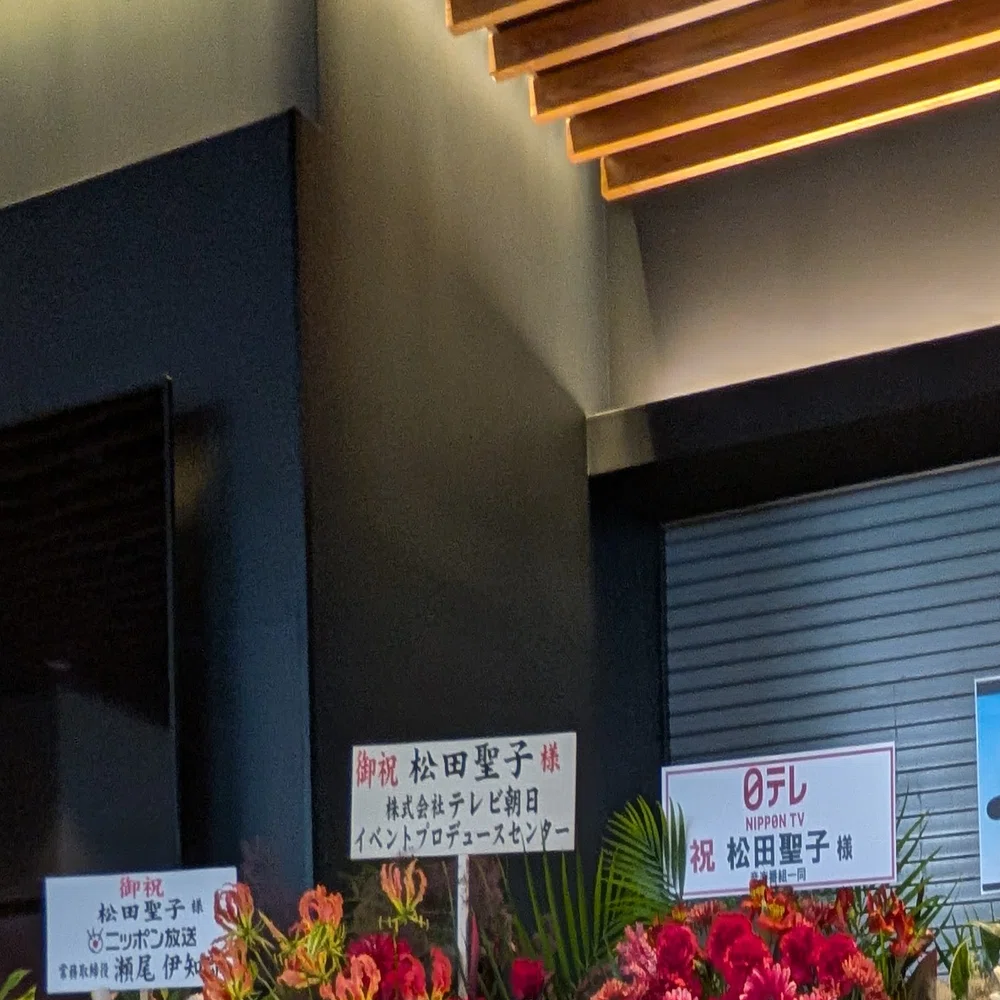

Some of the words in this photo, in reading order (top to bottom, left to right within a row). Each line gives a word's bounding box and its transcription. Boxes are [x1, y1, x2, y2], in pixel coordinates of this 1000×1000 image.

[356, 749, 399, 789] 御祝
[409, 739, 534, 784] 松田聖子
[541, 741, 561, 774] 様
[386, 785, 539, 821] 株式会社テレビ朝日
[354, 818, 570, 853] イベントプロデュースセンター
[746, 814, 787, 831] NIPPON
[790, 812, 805, 828] TV
[689, 838, 716, 873] 祝
[726, 829, 830, 871] 松田聖子
[837, 834, 853, 861] 様
[119, 876, 165, 899] 御祝
[97, 897, 186, 924] 松田聖子
[191, 897, 204, 915] 様
[105, 926, 197, 951] ニッポン放送
[114, 954, 156, 984] 瀬尾
[162, 952, 219, 980] 伊知
